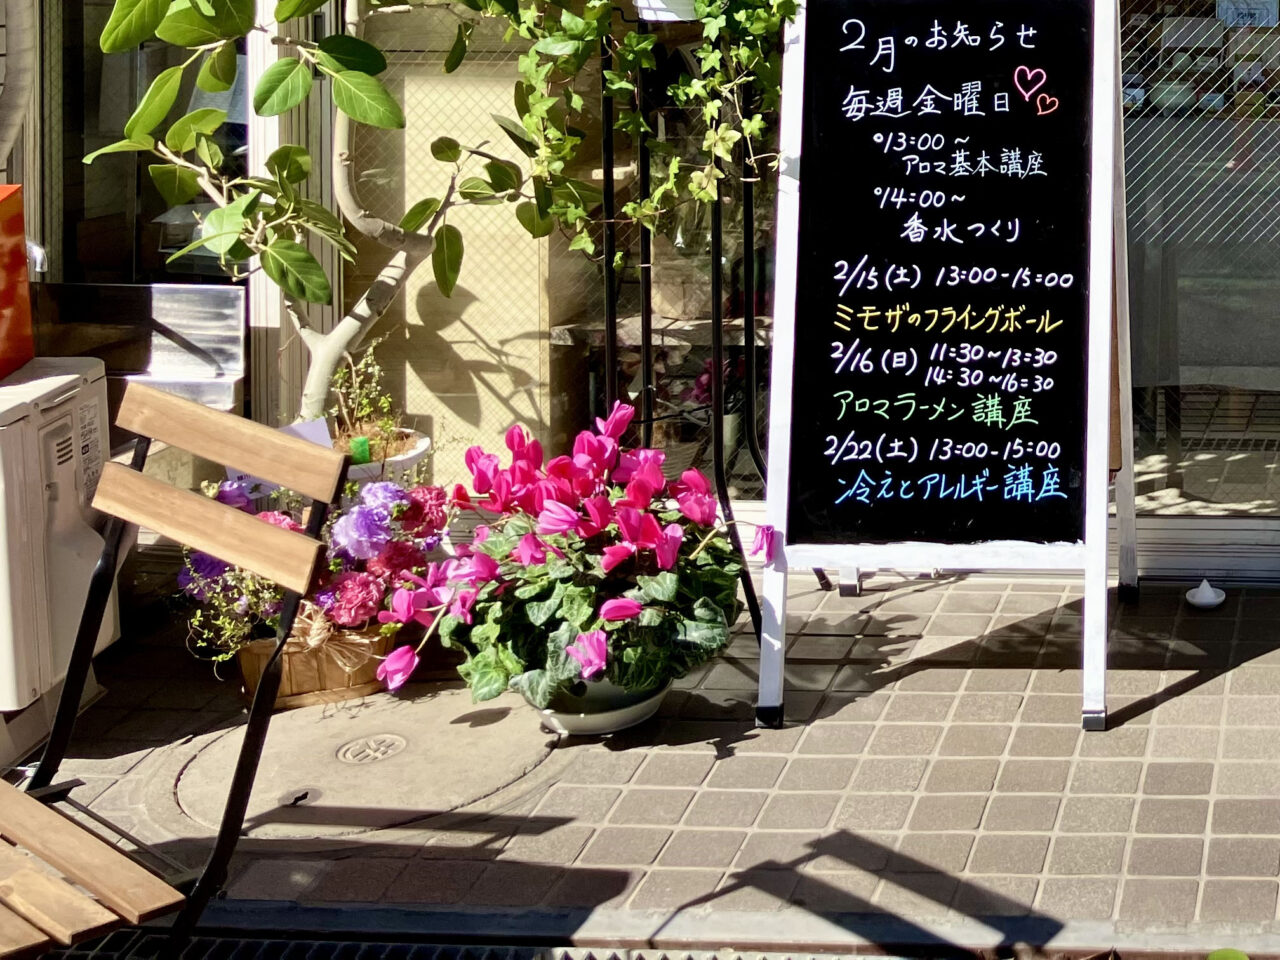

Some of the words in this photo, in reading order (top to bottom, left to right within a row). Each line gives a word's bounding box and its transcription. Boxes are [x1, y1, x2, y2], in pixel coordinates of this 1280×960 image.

[840, 18, 1038, 74] 2月のお知らせ
[841, 80, 1010, 122] 毎週金曜日
[901, 147, 1048, 180] アロマ基本講座
[899, 210, 1020, 244] 香水つくり
[833, 301, 1064, 334] ミモザのフライングボール
[834, 462, 1068, 505] 冷えとアレルギー講座
